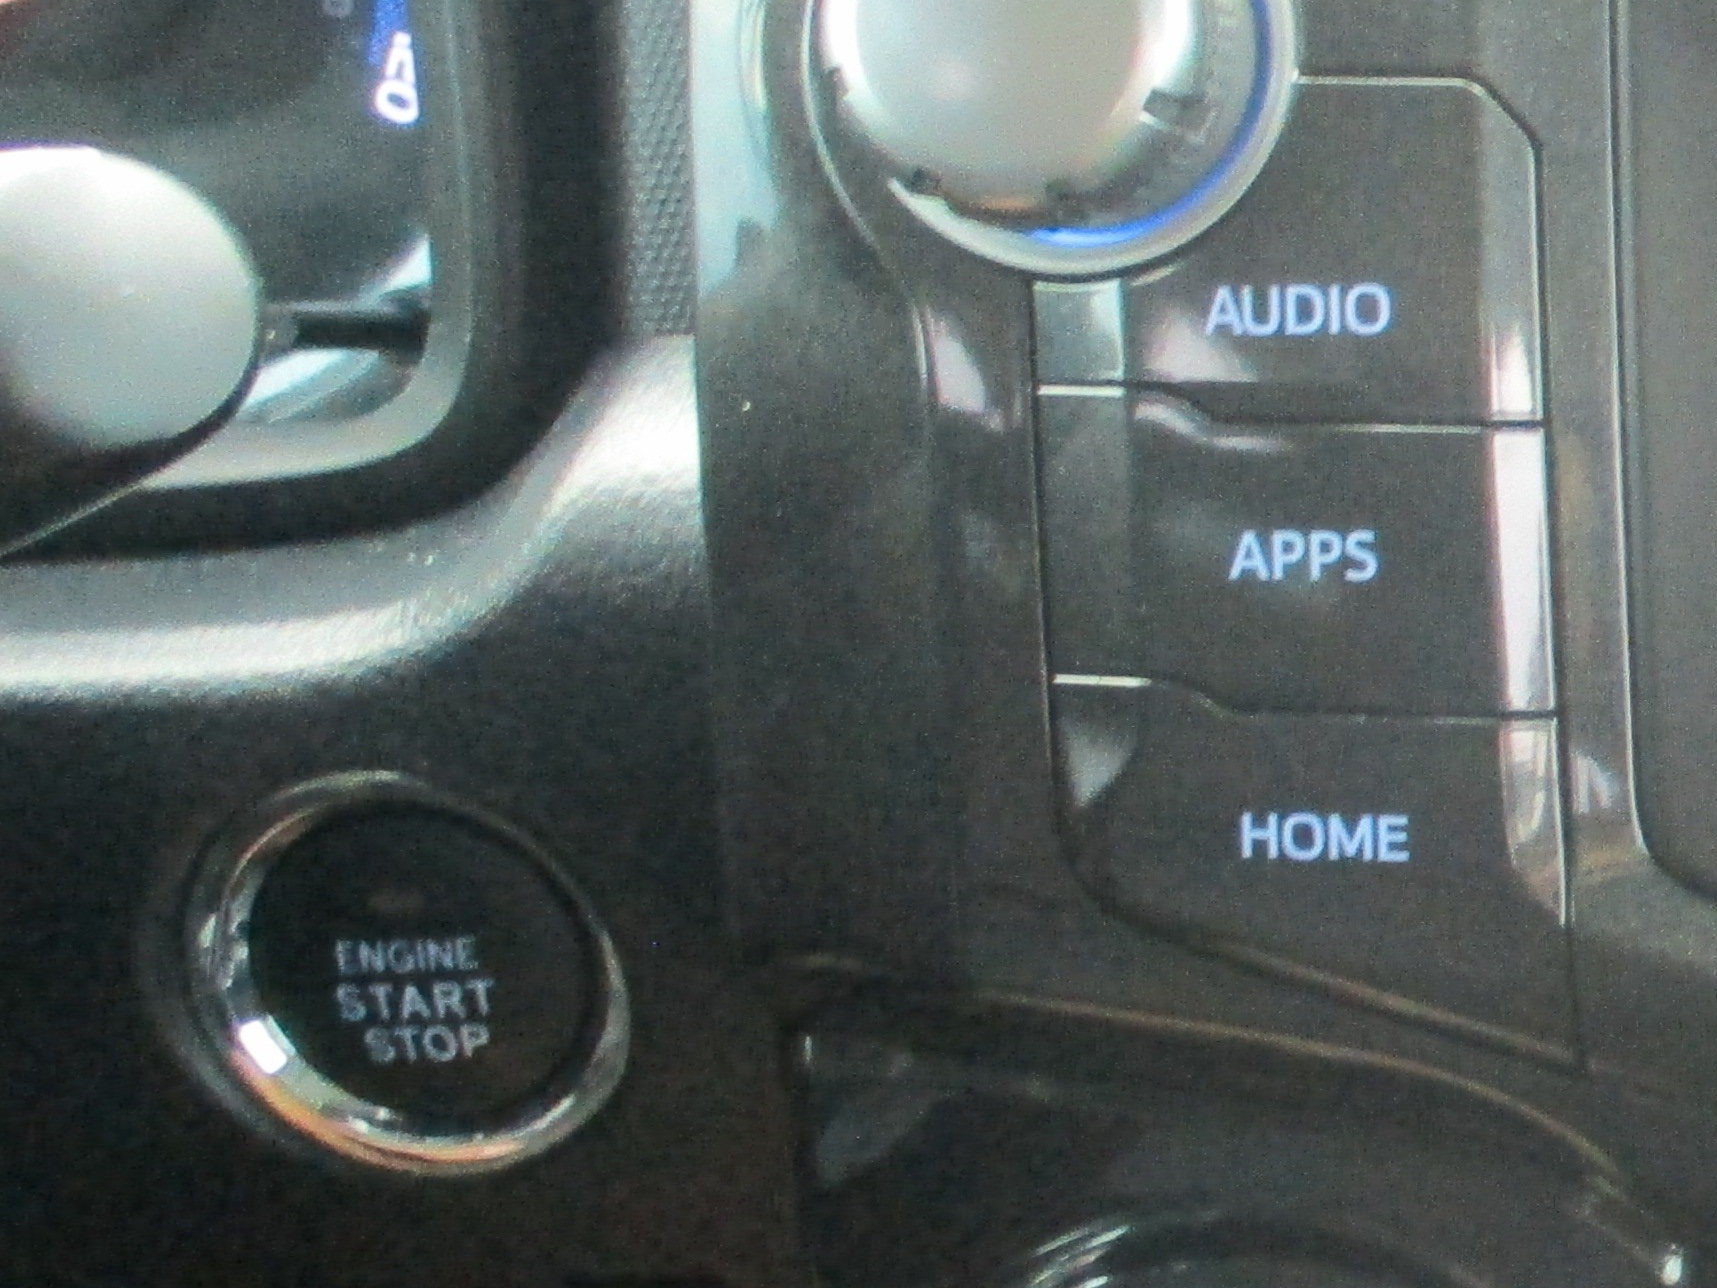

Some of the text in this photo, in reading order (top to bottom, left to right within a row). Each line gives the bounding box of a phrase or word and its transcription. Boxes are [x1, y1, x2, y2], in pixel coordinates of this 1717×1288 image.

[1203, 283, 1393, 338] AUDIO
[1228, 530, 1379, 584] APPS
[1240, 812, 1411, 864] HOME
[335, 935, 479, 975] ENGINE
[334, 978, 494, 1022] START
[364, 1023, 490, 1064] STOP
